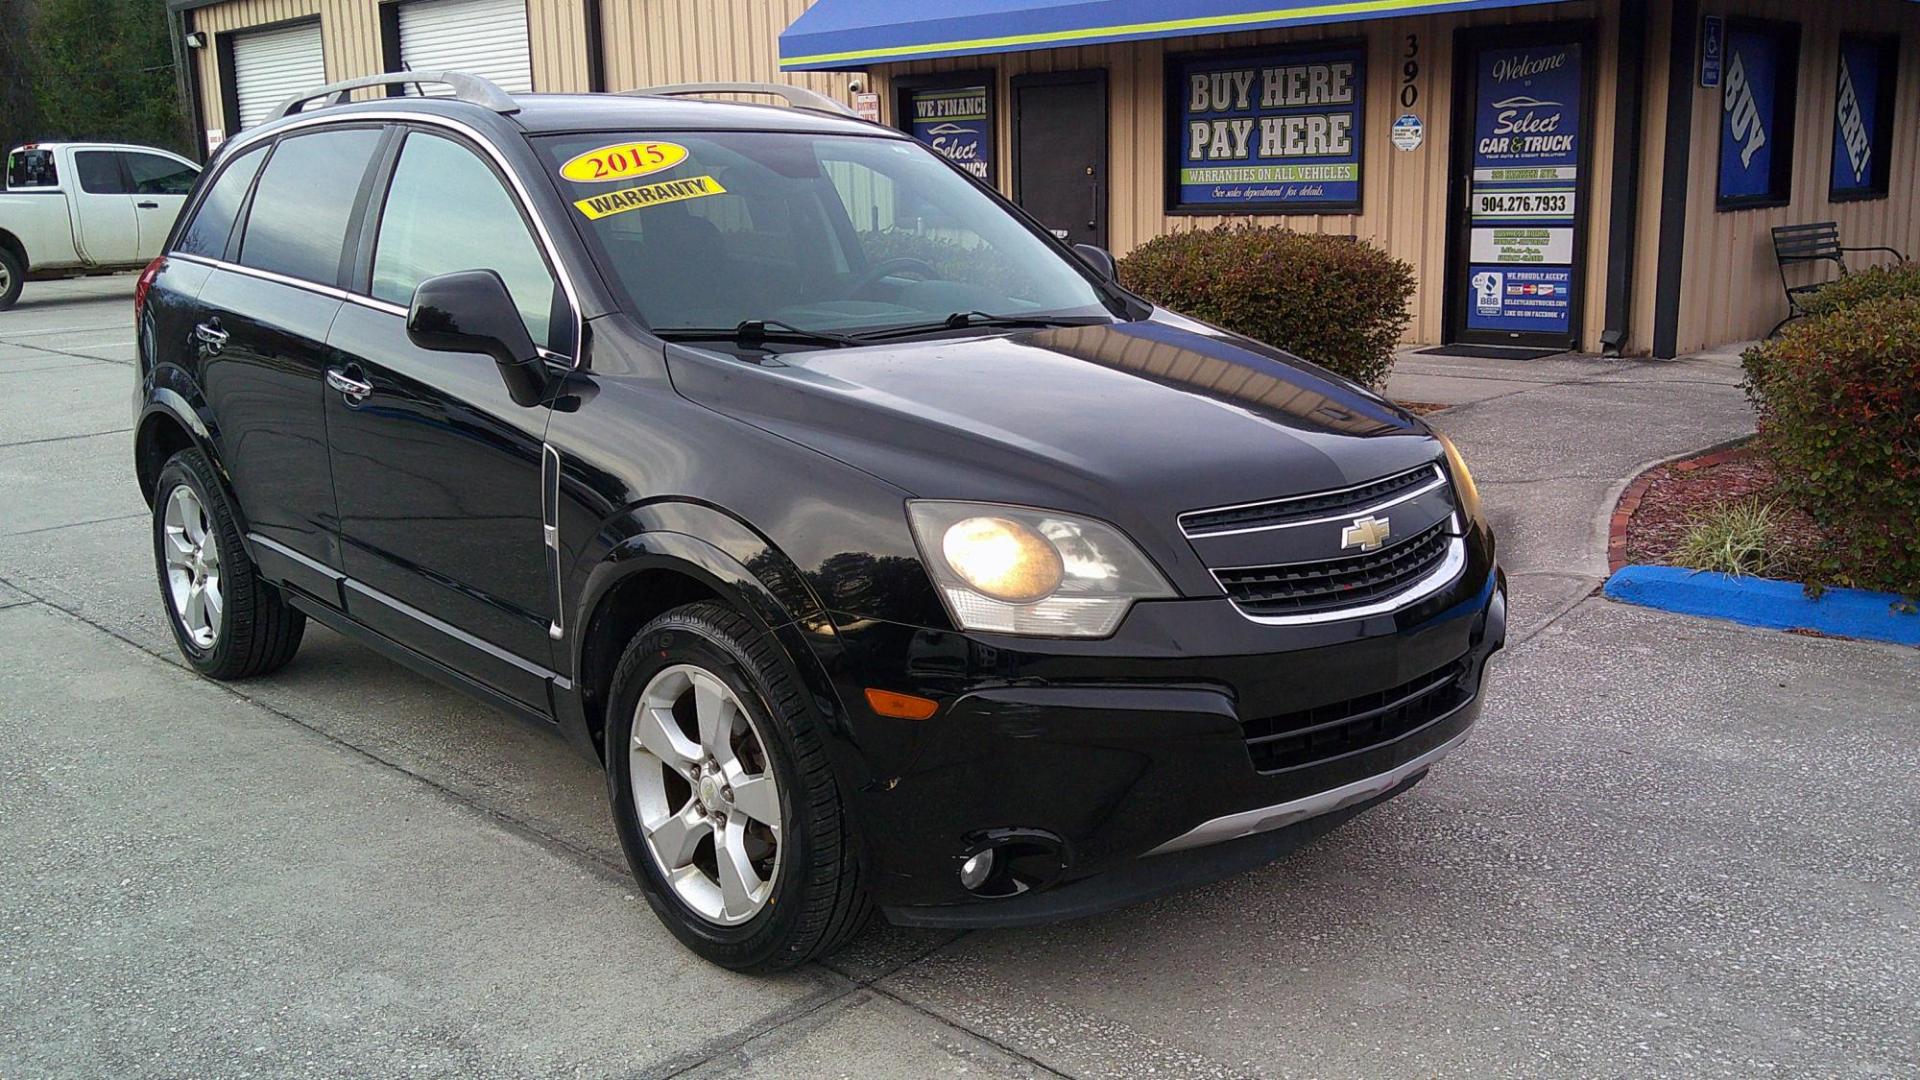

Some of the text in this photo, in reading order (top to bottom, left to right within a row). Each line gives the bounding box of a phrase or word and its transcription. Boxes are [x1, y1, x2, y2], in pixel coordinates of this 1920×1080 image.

[1401, 33, 1418, 108] 390
[1492, 53, 1565, 82] Welcome
[1189, 63, 1353, 112] BUY HERE
[916, 100, 934, 118] WE
[1725, 51, 1765, 170] BUY
[1494, 109, 1561, 134] Select
[932, 136, 977, 159] Select
[1189, 118, 1254, 160] PAY
[1259, 114, 1353, 157] HERE
[1479, 135, 1575, 154] CAR & TRUCK
[587, 144, 664, 178] 2015
[1189, 166, 1351, 182] WARRANTIES ON ALL VEHICLES
[588, 178, 706, 214] WARRANTY
[1212, 185, 1225, 198] See
[1225, 186, 1242, 198] sales
[1243, 185, 1284, 200] department
[1281, 186, 1298, 200] for
[1482, 196, 1566, 212] 904.276.7933
[1517, 272, 1544, 280] PROUDLY
[1545, 272, 1568, 280] ACCEPT
[1480, 297, 1499, 305] BBB
